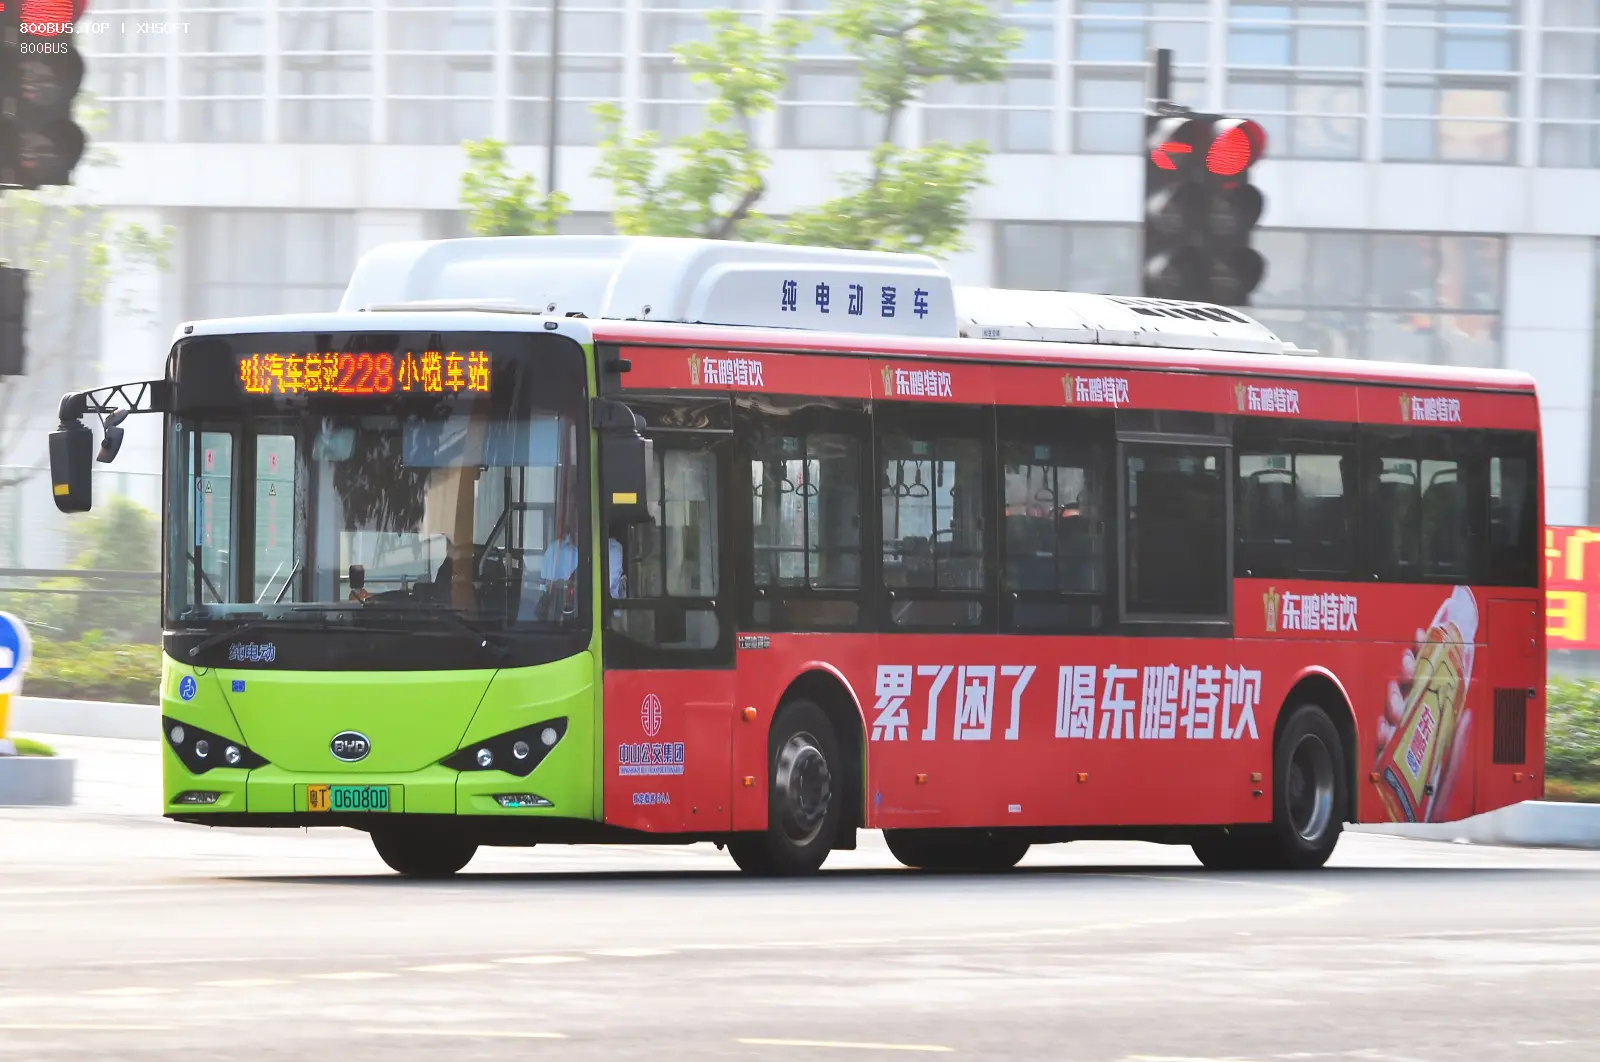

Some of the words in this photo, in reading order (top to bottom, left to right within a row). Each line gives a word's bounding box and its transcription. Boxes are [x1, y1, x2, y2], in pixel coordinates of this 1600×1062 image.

[781, 279, 929, 319] 纯电动客车
[338, 353, 395, 394] 228
[398, 351, 489, 392] 小榄车站
[703, 356, 764, 387] 东鹏特饮
[895, 367, 953, 397] 东鹏特饮
[1075, 375, 1130, 404] 东鹏特饮
[1247, 384, 1300, 414] 东鹏特饮
[1411, 395, 1461, 422] 东鹏特饮
[1281, 591, 1358, 632] 东鹏特饮
[229, 642, 276, 662] 纯电动
[871, 664, 1037, 741] 累了困了
[1055, 663, 1262, 741] 喝东鹏特饮
[334, 740, 366, 753] BYD
[618, 742, 685, 765] 中山公交集团
